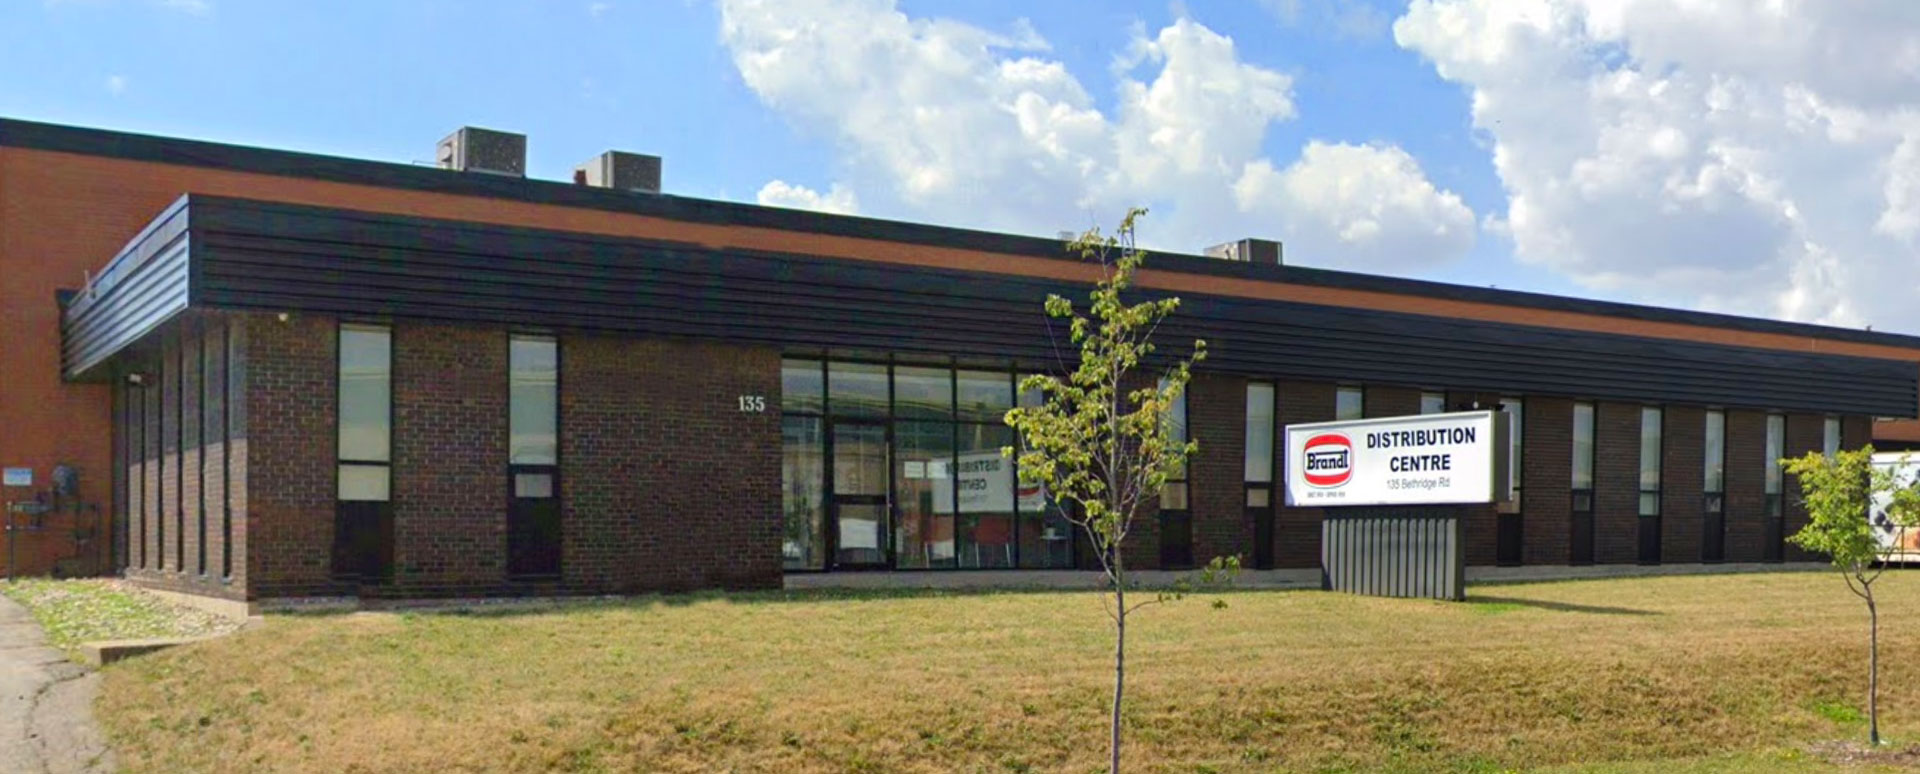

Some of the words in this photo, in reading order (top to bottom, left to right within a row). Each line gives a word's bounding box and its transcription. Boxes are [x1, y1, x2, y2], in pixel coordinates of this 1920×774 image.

[738, 396, 765, 412] 135
[1367, 427, 1476, 449] DISTRIBUTION
[1306, 449, 1349, 470] Brandt
[1390, 454, 1451, 472] CENTRE
[1387, 477, 1400, 490] 135
[1402, 477, 1437, 491] Bethridge
[1438, 476, 1451, 488] Rd
